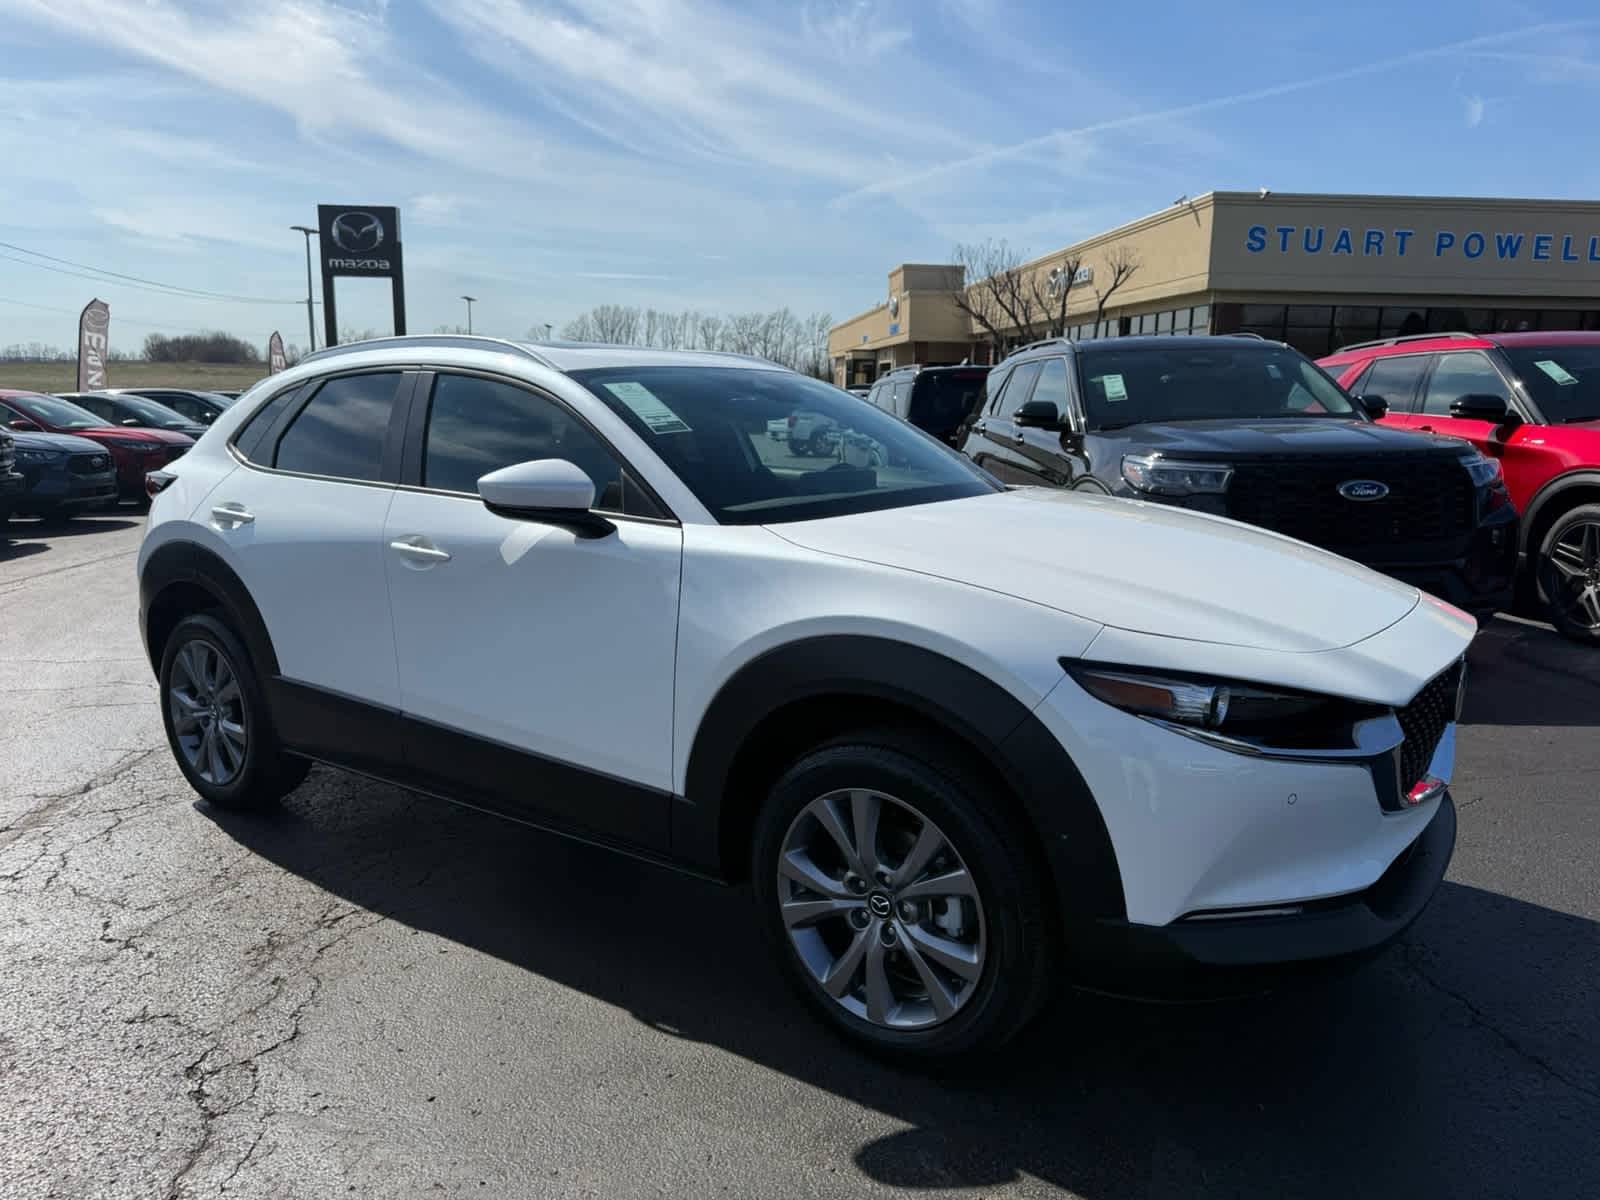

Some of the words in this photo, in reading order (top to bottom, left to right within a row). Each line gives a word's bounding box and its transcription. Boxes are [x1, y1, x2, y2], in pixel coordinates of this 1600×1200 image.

[1245, 225, 1413, 256] STUART
[1435, 231, 1600, 262] POWELL
[328, 257, 391, 270] mazda
